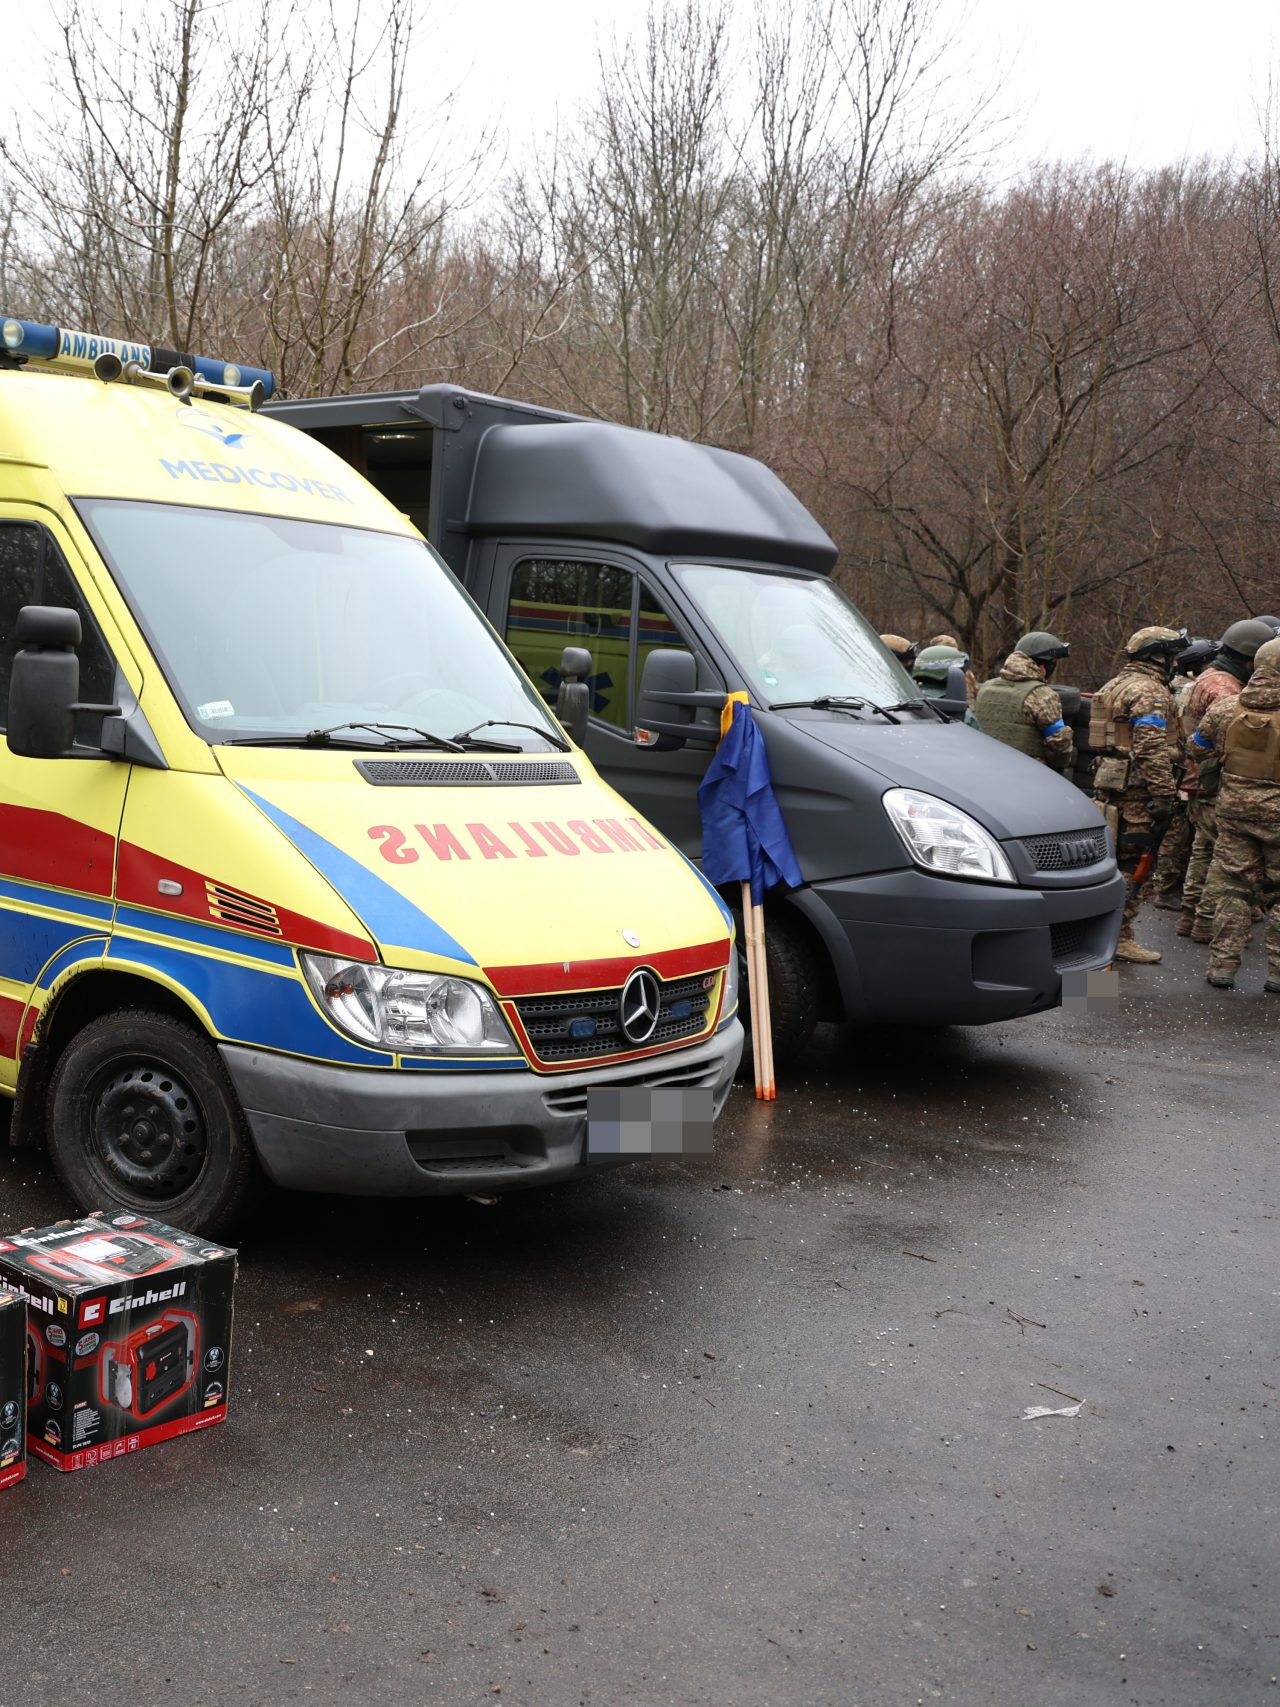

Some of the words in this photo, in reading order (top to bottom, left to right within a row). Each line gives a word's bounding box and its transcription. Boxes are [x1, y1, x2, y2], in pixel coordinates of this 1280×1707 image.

[160, 458, 354, 504] MEDICOVER
[12, 1225, 94, 1247] Einhell
[108, 1281, 187, 1315] Einhell
